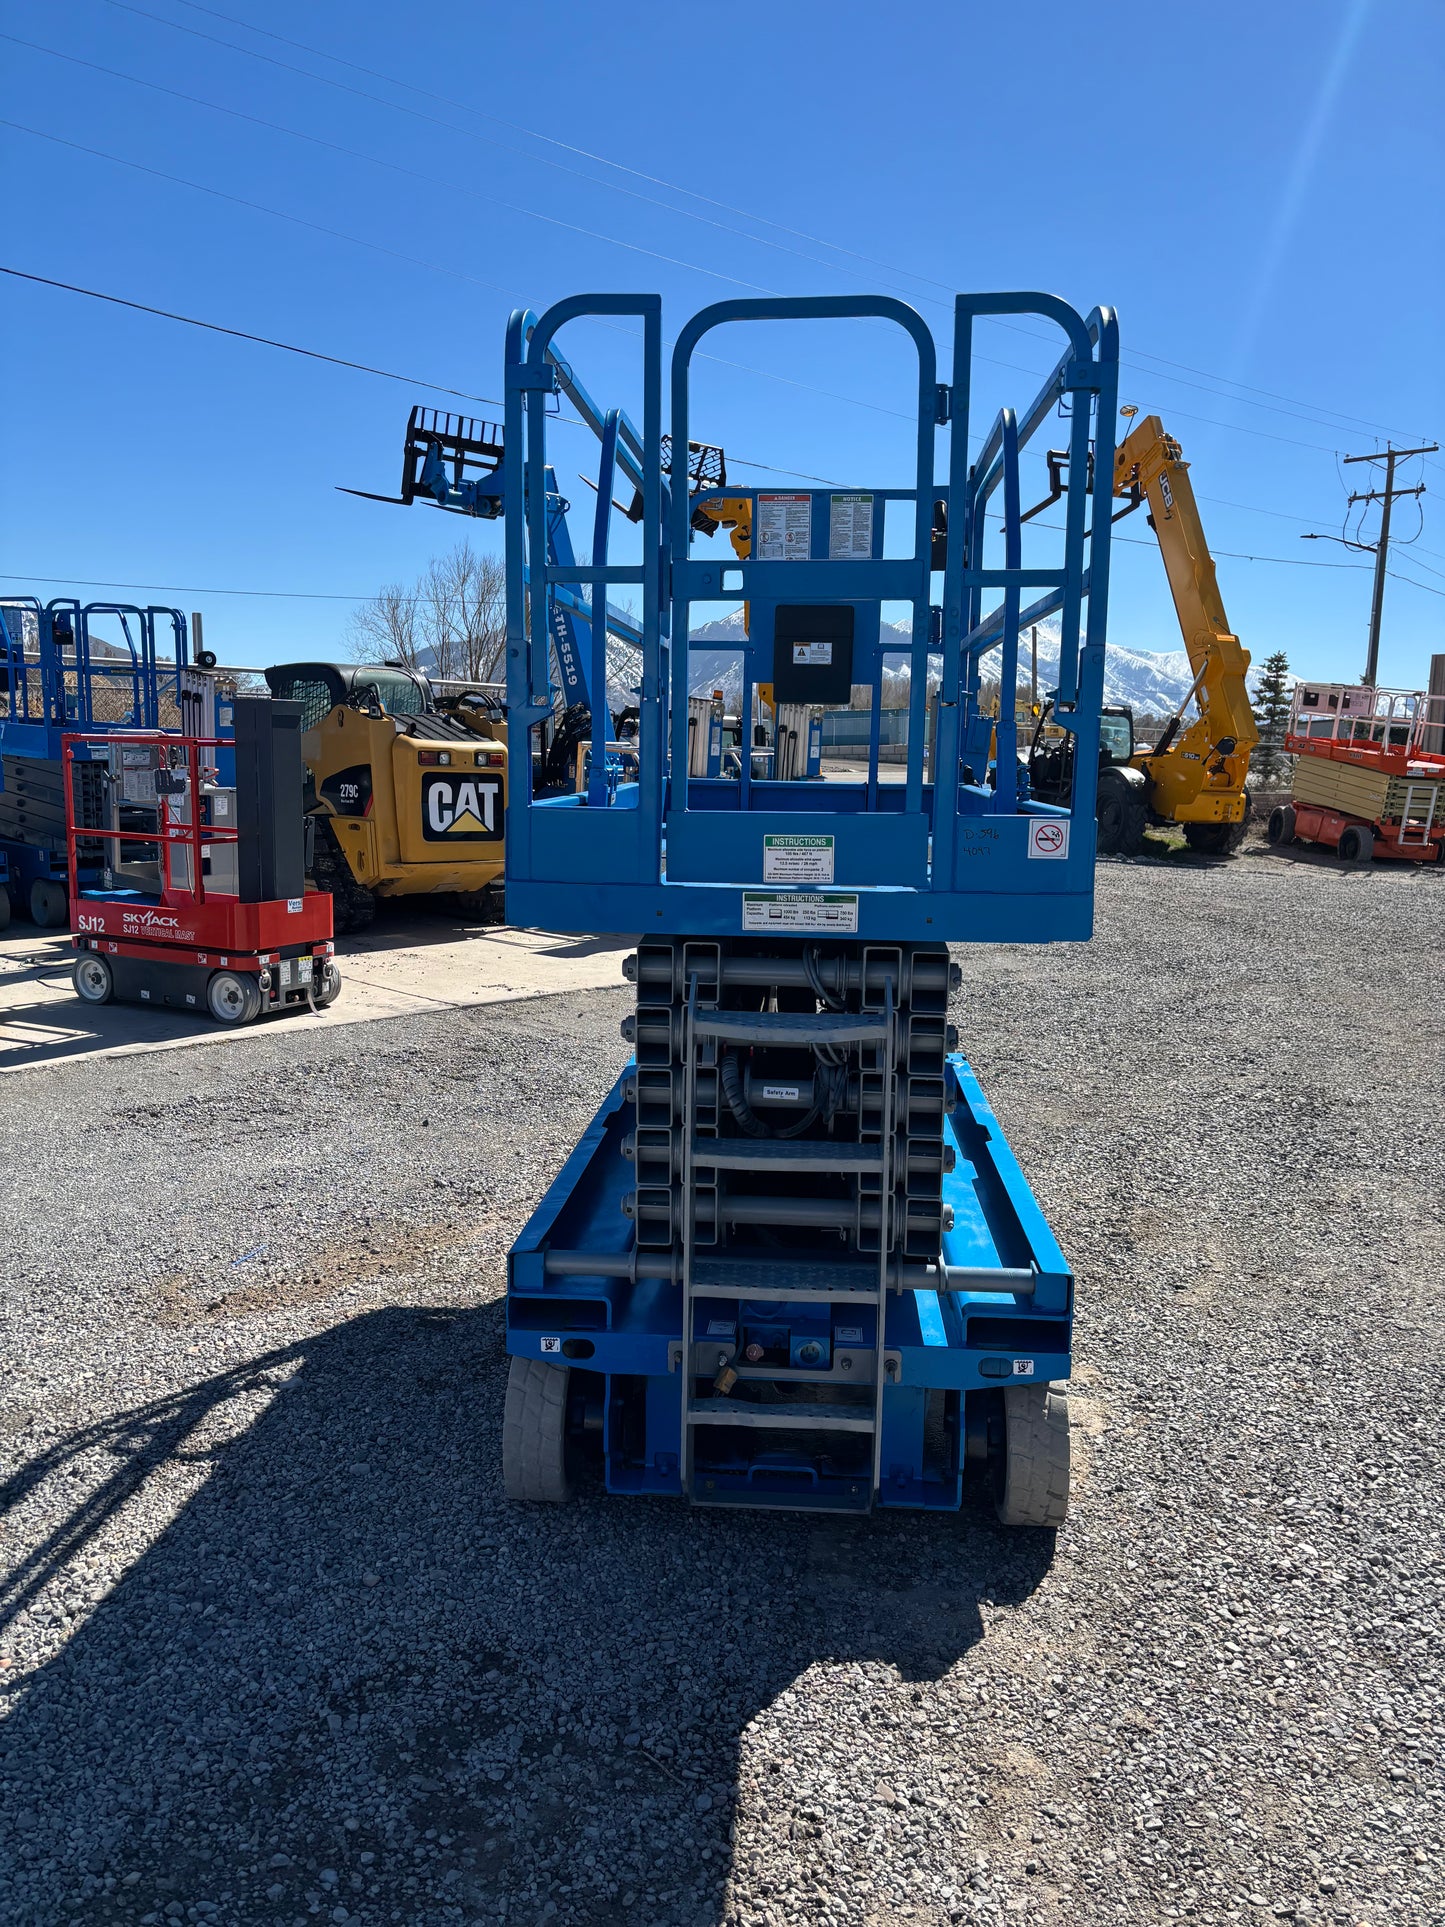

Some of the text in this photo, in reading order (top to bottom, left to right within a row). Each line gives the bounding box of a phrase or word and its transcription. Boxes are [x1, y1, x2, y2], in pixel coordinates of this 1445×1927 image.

[1160, 474, 1173, 508] JCB
[340, 784, 358, 798] 279C
[428, 782, 498, 832] CAT
[78, 914, 105, 932] SJ12
[123, 911, 179, 927] SKYJACK
[123, 924, 195, 940] SJ12 VERTICAL MAST
